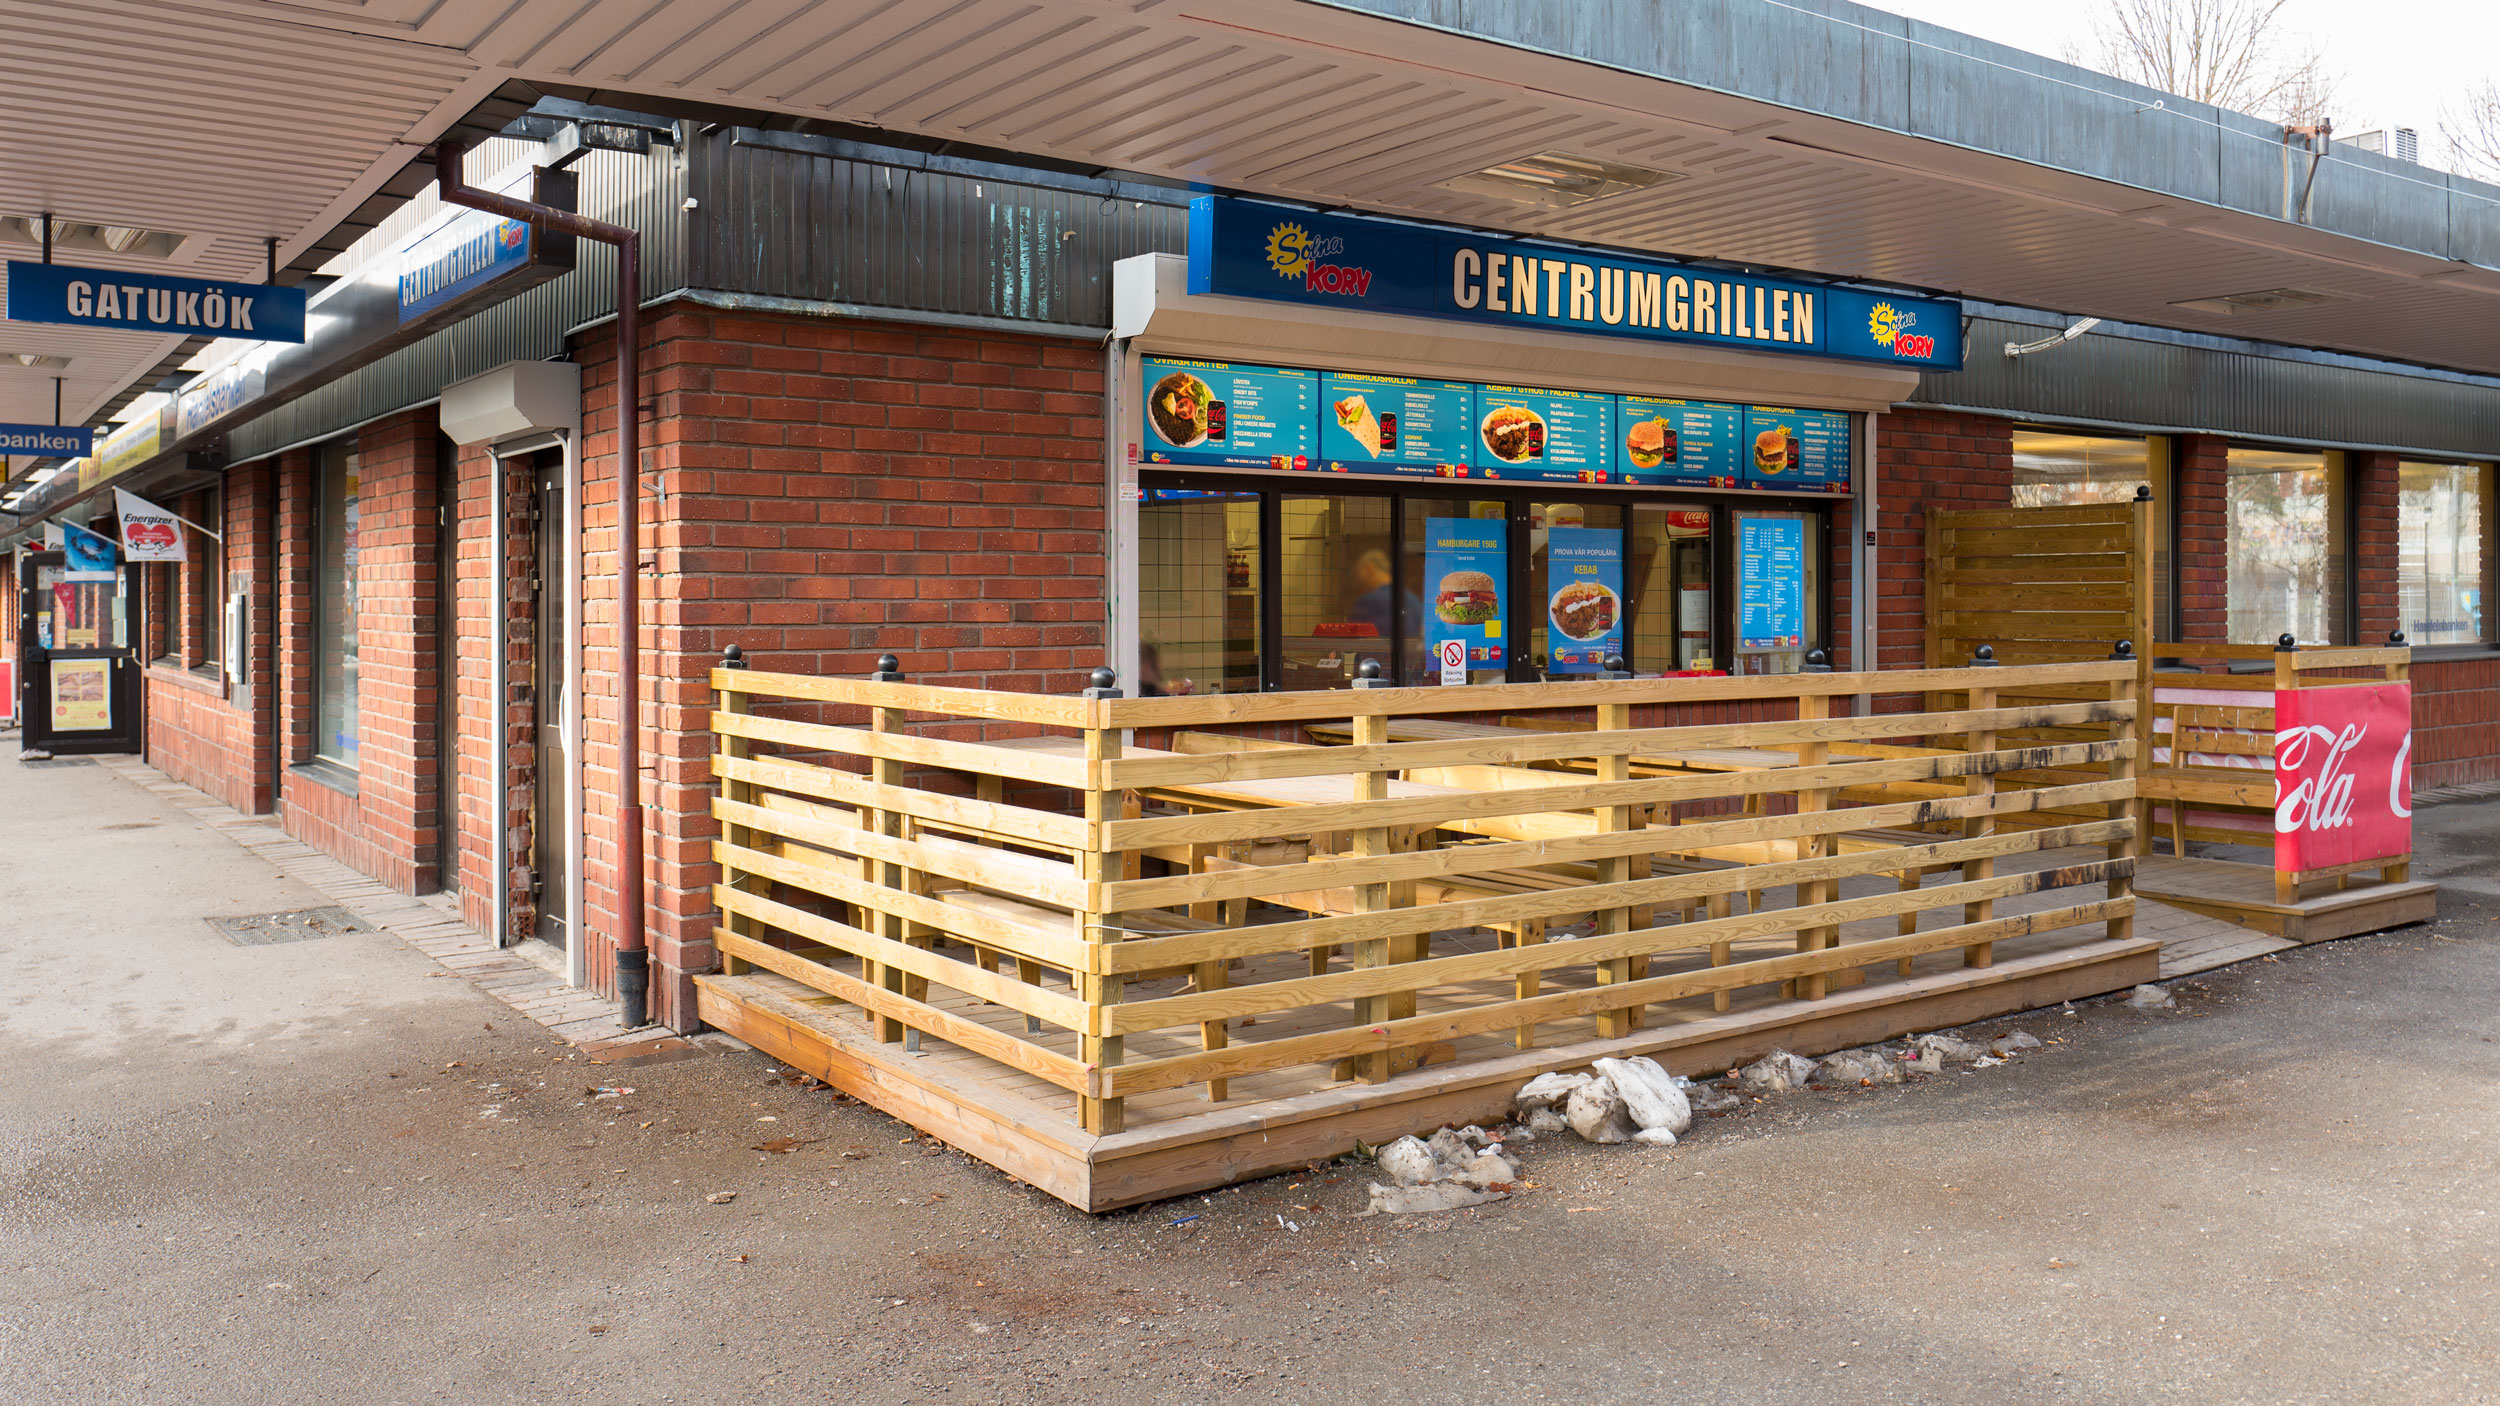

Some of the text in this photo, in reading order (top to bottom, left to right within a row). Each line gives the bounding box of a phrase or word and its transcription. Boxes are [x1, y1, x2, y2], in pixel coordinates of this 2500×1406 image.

[1276, 232, 1344, 266] Solna
[1306, 260, 1372, 297] KORV
[67, 280, 254, 331] GATUKÖK
[1453, 248, 1814, 345] CENTRUMGRILLEN
[1876, 310, 1917, 336] Solna
[1894, 330, 1935, 359] KORV
[123, 512, 174, 525] Energizer
[1437, 539, 1497, 549] HAMBURGARE 150G
[1554, 547, 1617, 556] PROVA VÅR POPULÄRA
[1574, 565, 1598, 575] KEBAB
[2413, 618, 2469, 633] Handelsbanken
